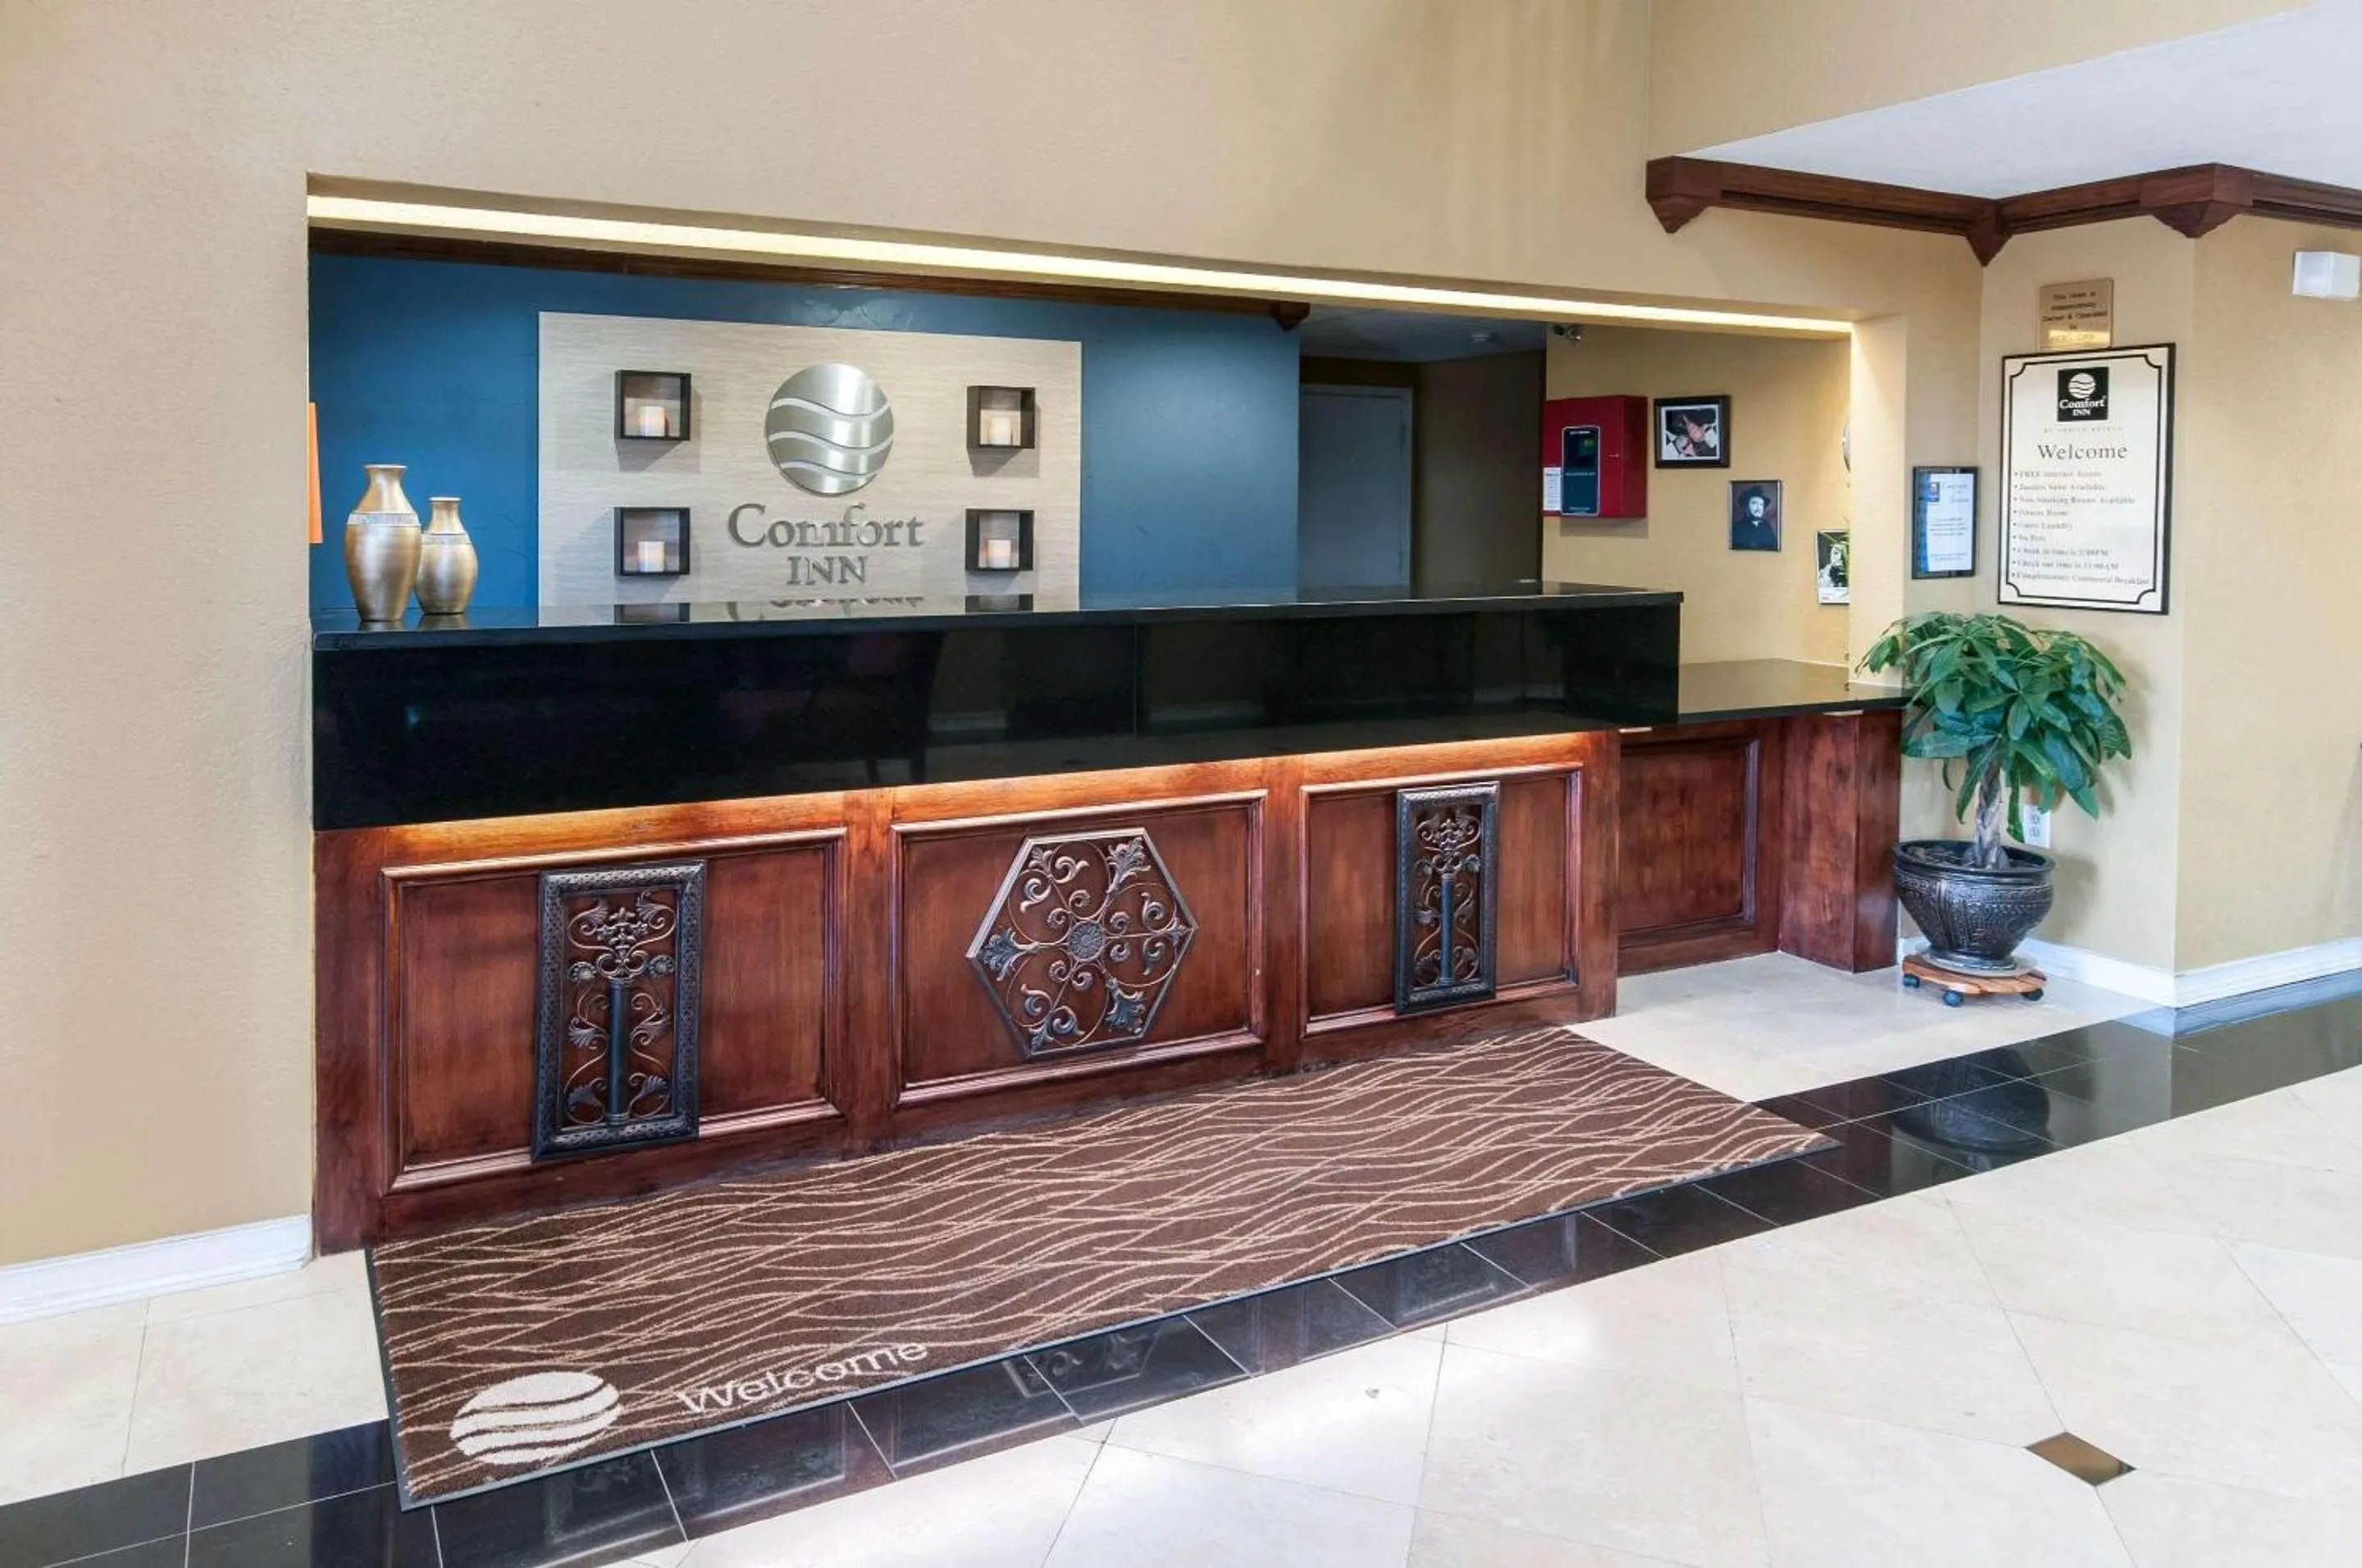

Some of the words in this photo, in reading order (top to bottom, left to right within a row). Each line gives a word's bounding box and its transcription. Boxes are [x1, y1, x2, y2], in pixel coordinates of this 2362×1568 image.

[2059, 397, 2105, 409] Comfort
[2037, 444, 2128, 459] Welcome
[727, 502, 925, 548] Comfort
[787, 555, 869, 586] INN
[675, 1342, 928, 1414] Welcome
